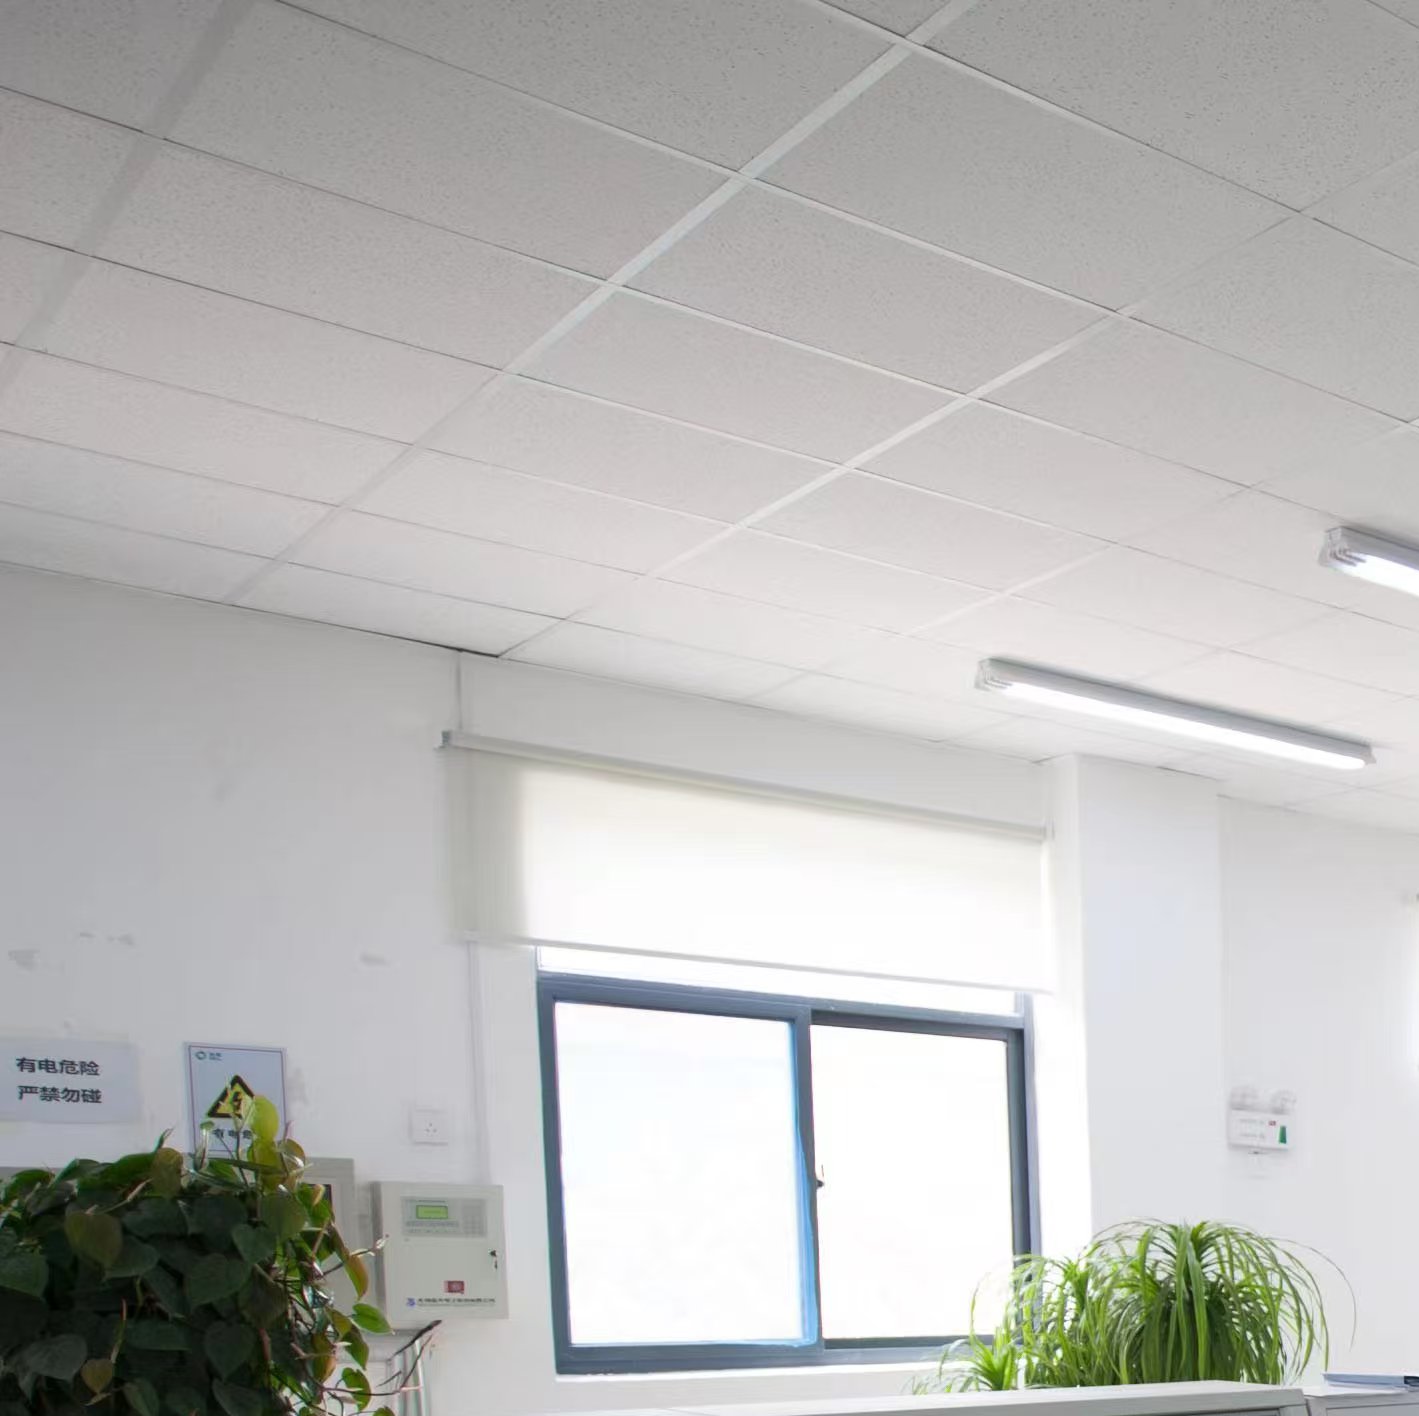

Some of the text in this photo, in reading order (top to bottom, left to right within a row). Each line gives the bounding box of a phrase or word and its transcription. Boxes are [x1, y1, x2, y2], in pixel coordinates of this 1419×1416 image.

[16, 1057, 100, 1076] 有电危险
[18, 1085, 102, 1104] 严禁勿碰
[213, 1126, 255, 1141] 有电危
